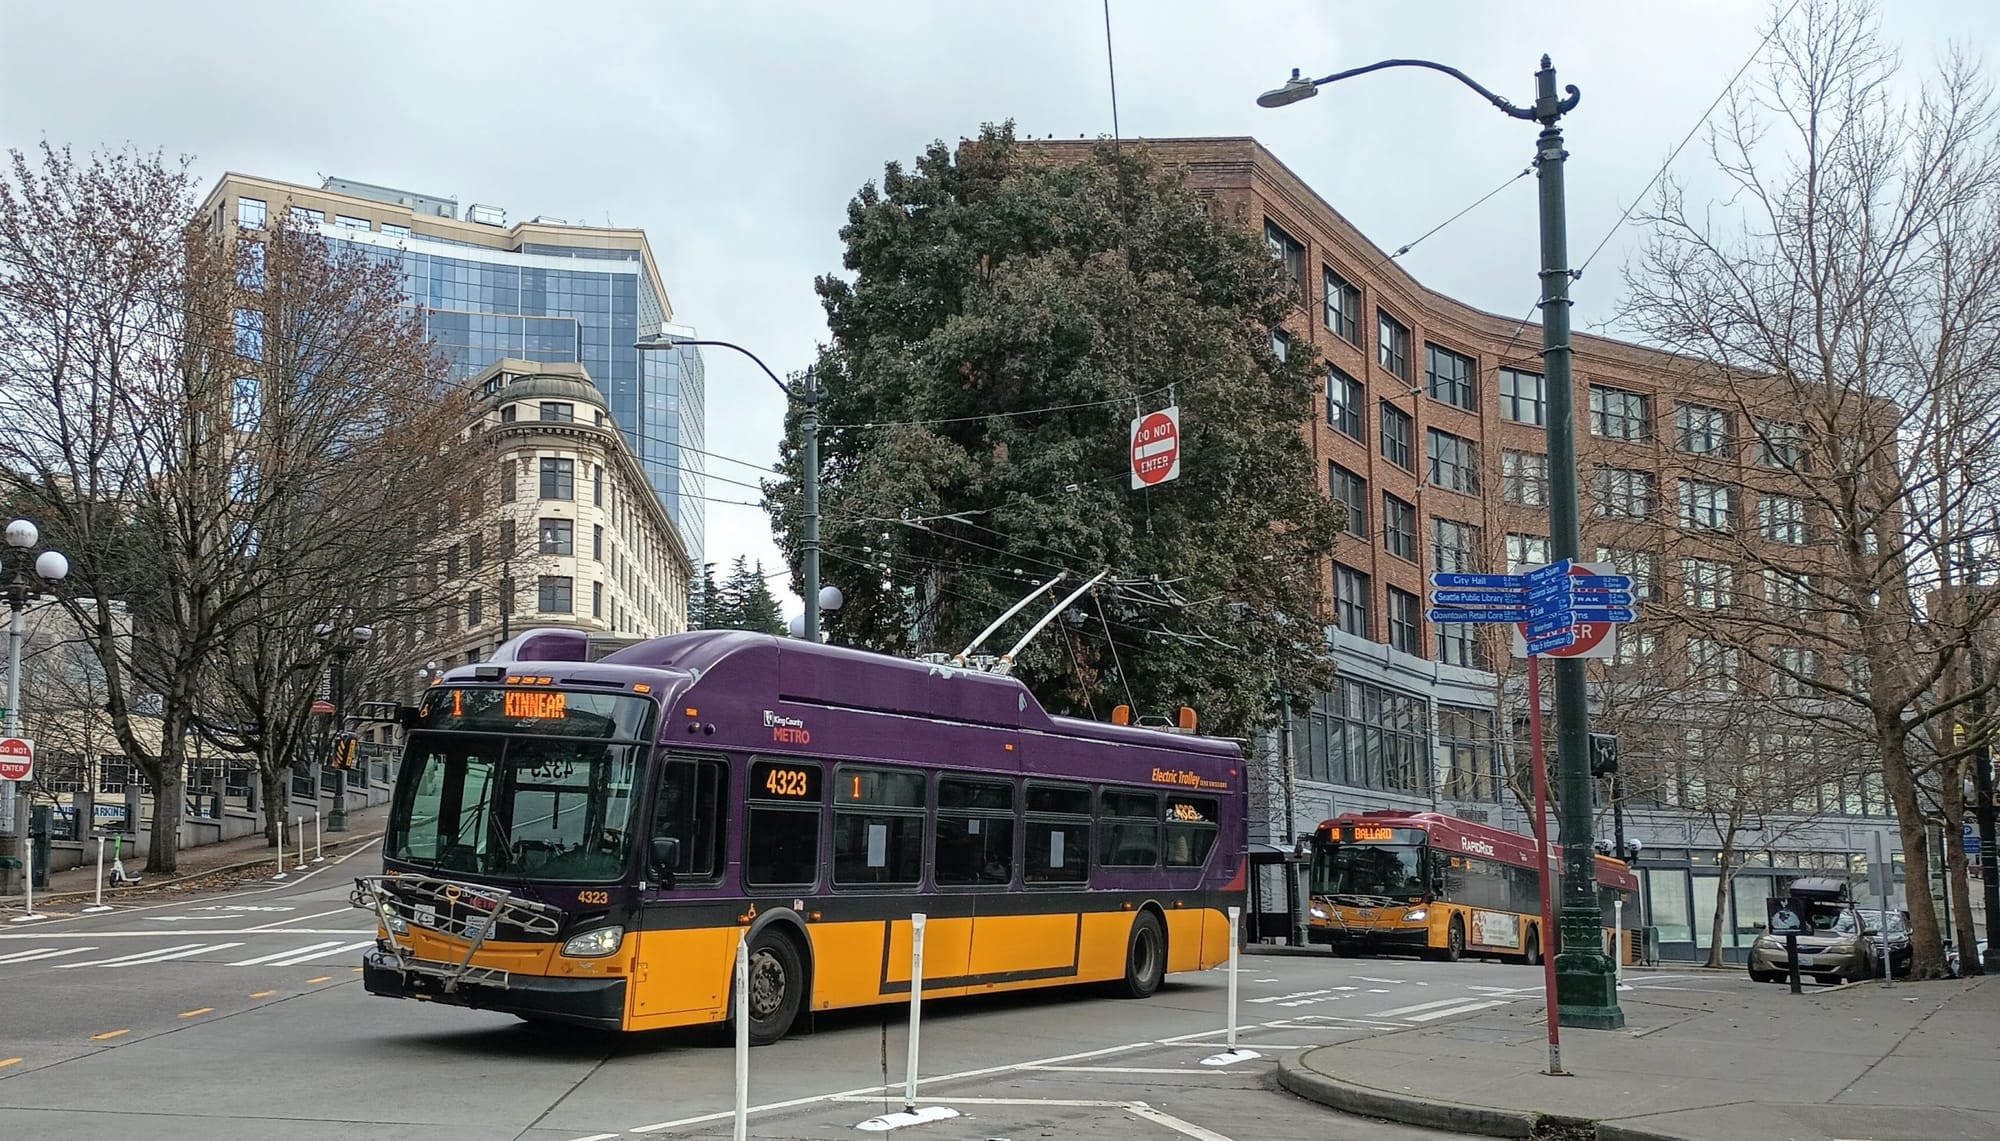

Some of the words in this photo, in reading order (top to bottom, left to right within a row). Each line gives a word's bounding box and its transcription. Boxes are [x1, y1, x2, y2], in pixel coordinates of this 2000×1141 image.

[1138, 430, 1150, 442] DO
[1154, 423, 1171, 438] NOT
[1141, 456, 1168, 473] ENTER
[1453, 576, 1469, 585] City
[1471, 577, 1487, 585] Hall
[1437, 593, 1460, 601] Seattle
[1461, 593, 1481, 601] Public
[1481, 594, 1503, 604] Library
[1433, 611, 1467, 619] Downtown
[1487, 611, 1504, 619] Core
[453, 689, 463, 717] 1
[504, 691, 566, 719] KINNEAR
[773, 716, 785, 726] King
[786, 717, 803, 728] County
[774, 727, 810, 743] METRO
[0, 746, 10, 754] DO
[13, 747, 27, 755] NOT
[1, 764, 24, 773] ENTER
[767, 770, 806, 796] 4323
[1152, 768, 1177, 783] Electric
[1178, 771, 1200, 789] Trolley
[852, 776, 860, 798] 1
[94, 807, 125, 816] ARKING
[1354, 827, 1392, 840] BALLARD
[578, 890, 609, 905] 4323
